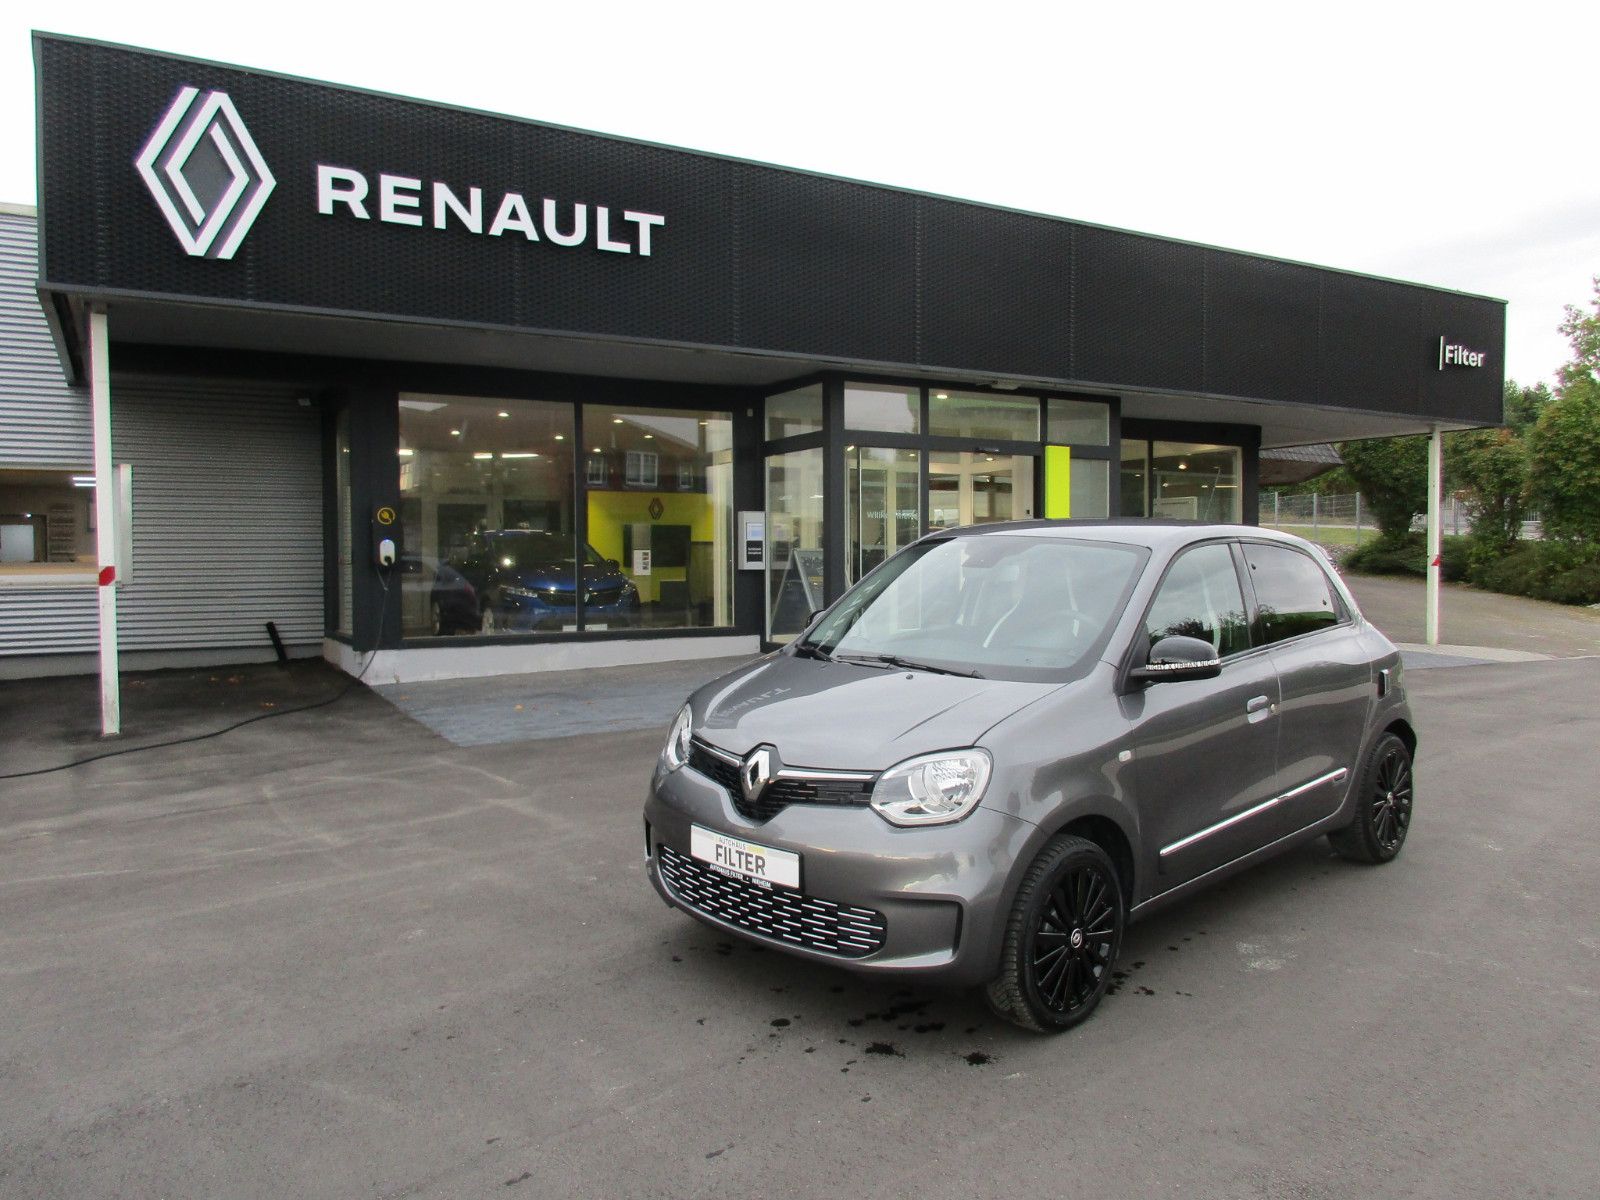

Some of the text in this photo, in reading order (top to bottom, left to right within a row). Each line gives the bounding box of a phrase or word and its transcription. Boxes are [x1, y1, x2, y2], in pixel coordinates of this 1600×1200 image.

[317, 165, 665, 256] RENAULT
[1445, 344, 1486, 368] Filter
[718, 836, 746, 850] AUTOHAUS
[715, 843, 766, 876] FILTER
